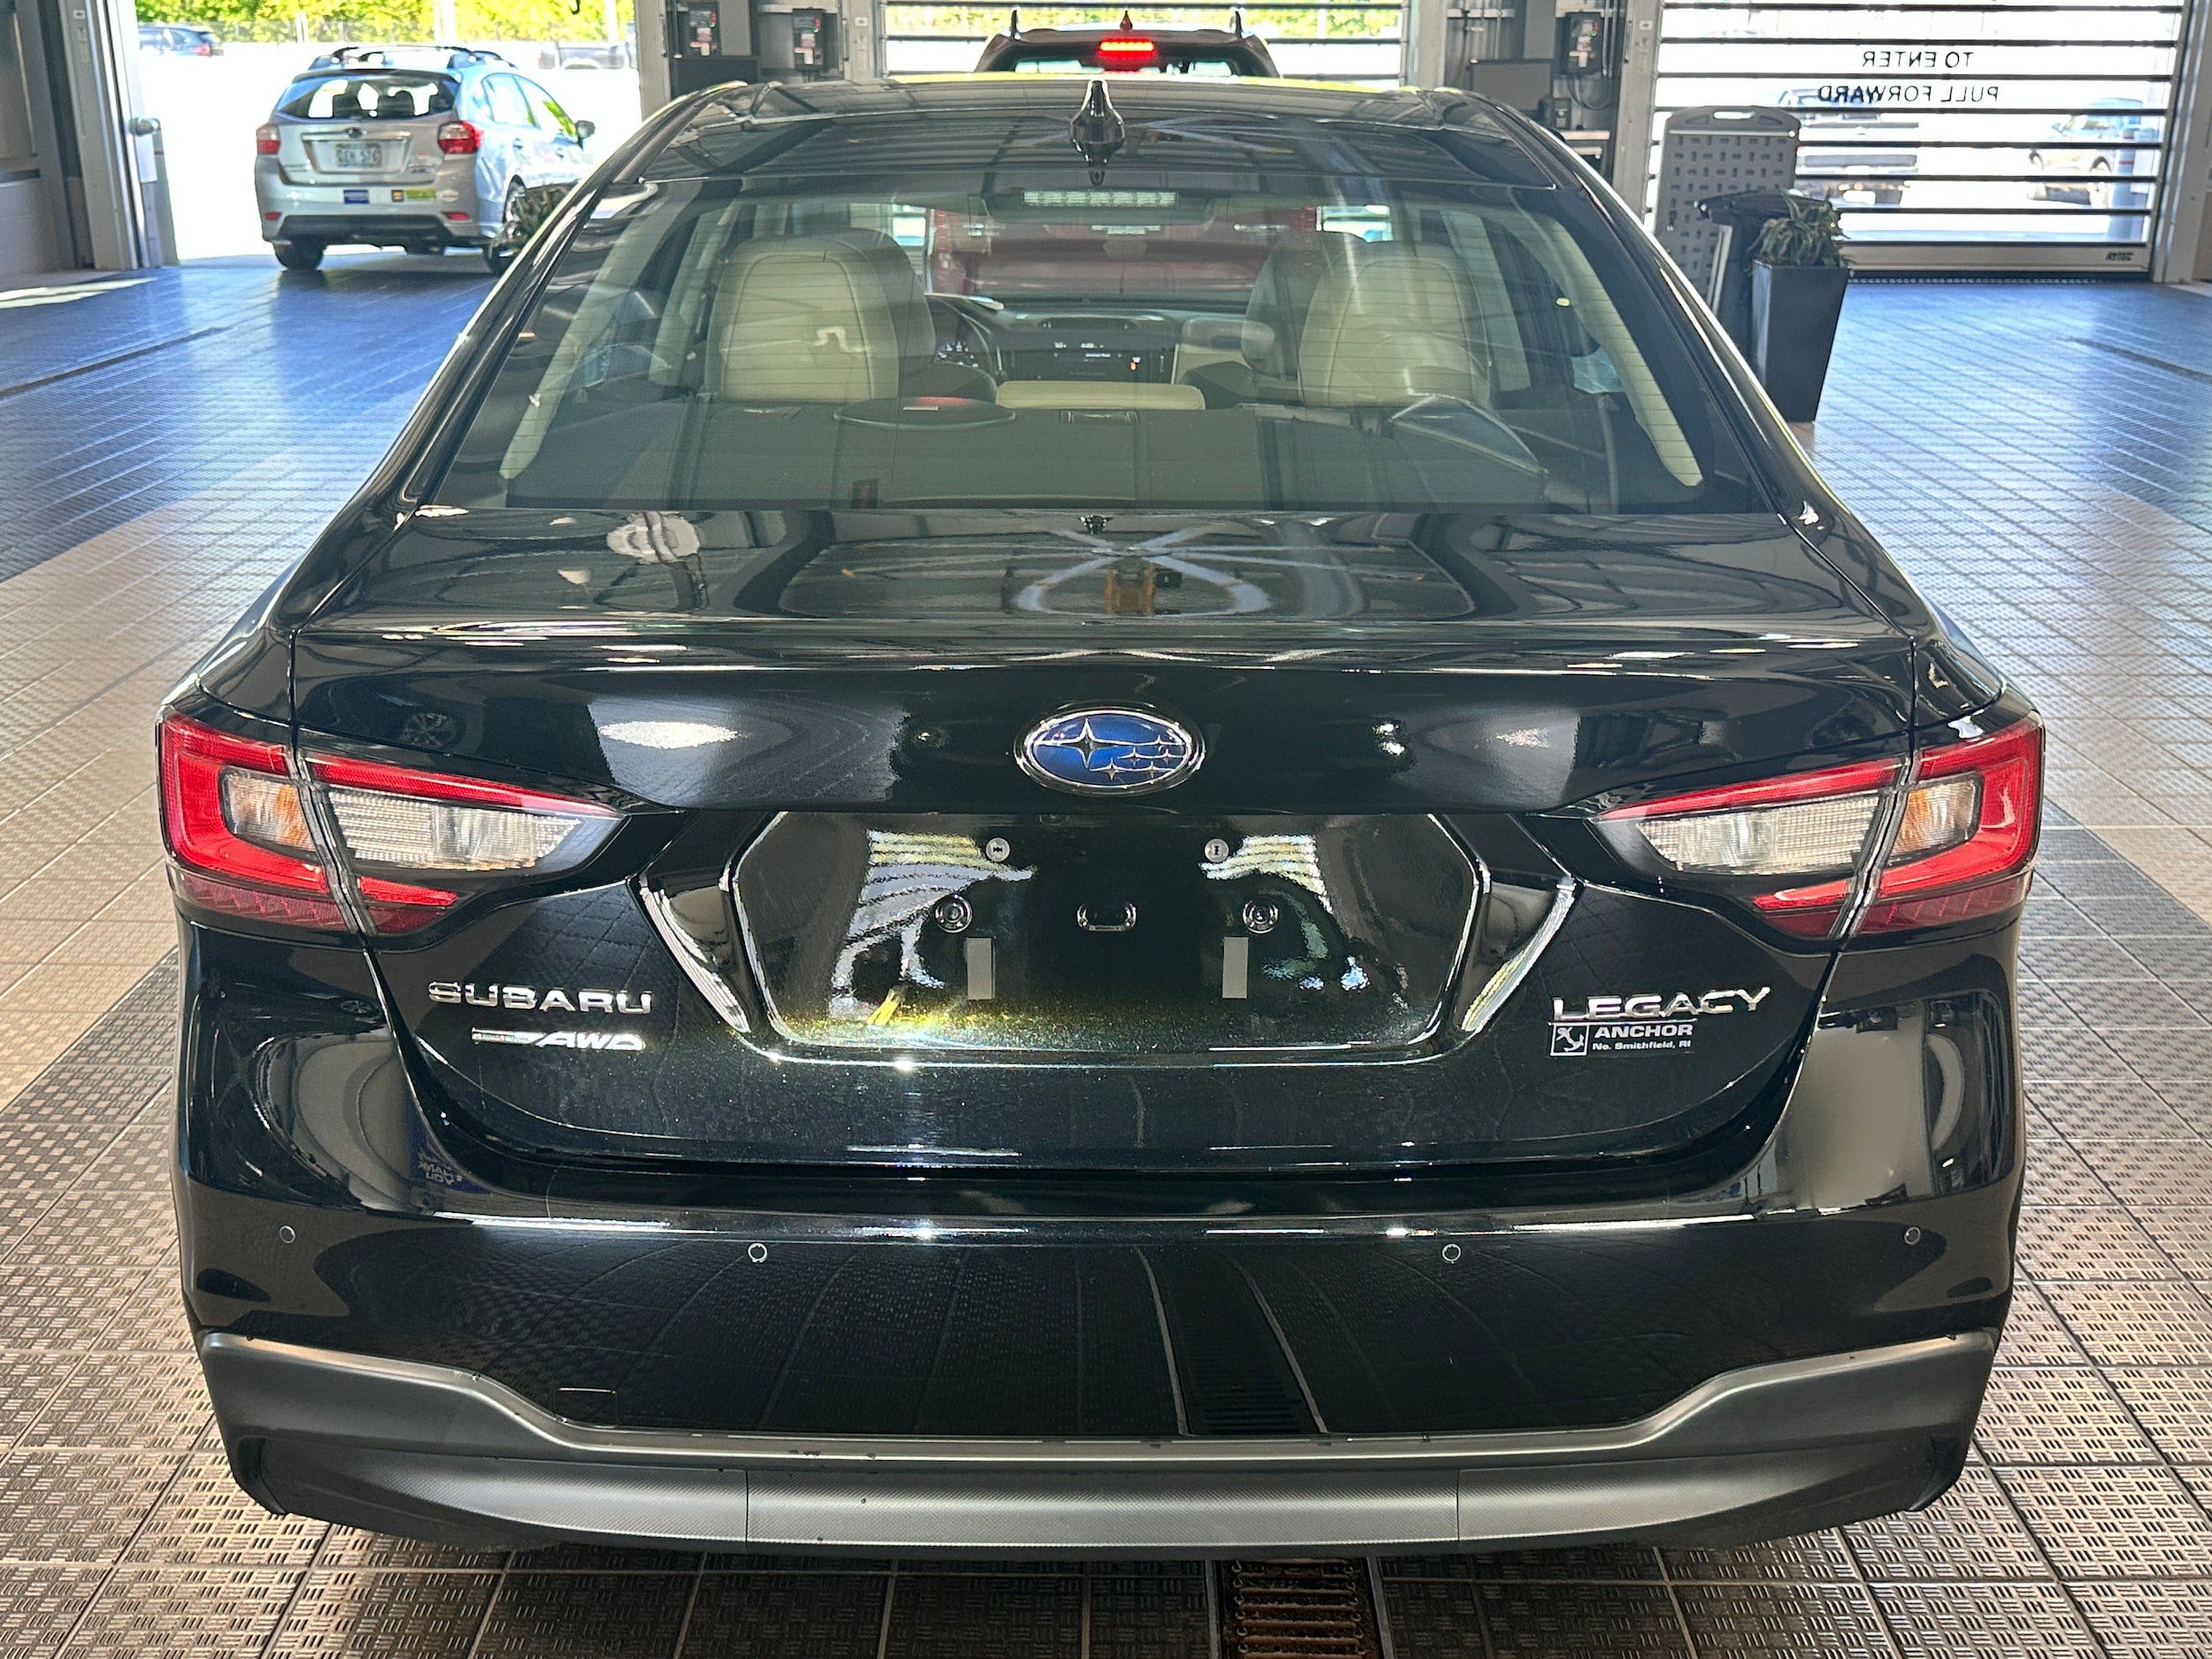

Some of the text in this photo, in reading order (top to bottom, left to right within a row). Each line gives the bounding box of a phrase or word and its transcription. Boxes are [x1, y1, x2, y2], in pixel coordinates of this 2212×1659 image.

[428, 981, 652, 1015] SUBARU
[1552, 987, 1770, 1020] LEGACY
[536, 1031, 645, 1051] AWD
[1594, 1024, 1694, 1040] ANCHOR
[1593, 1040, 1691, 1051] No. Smithfield, RI
